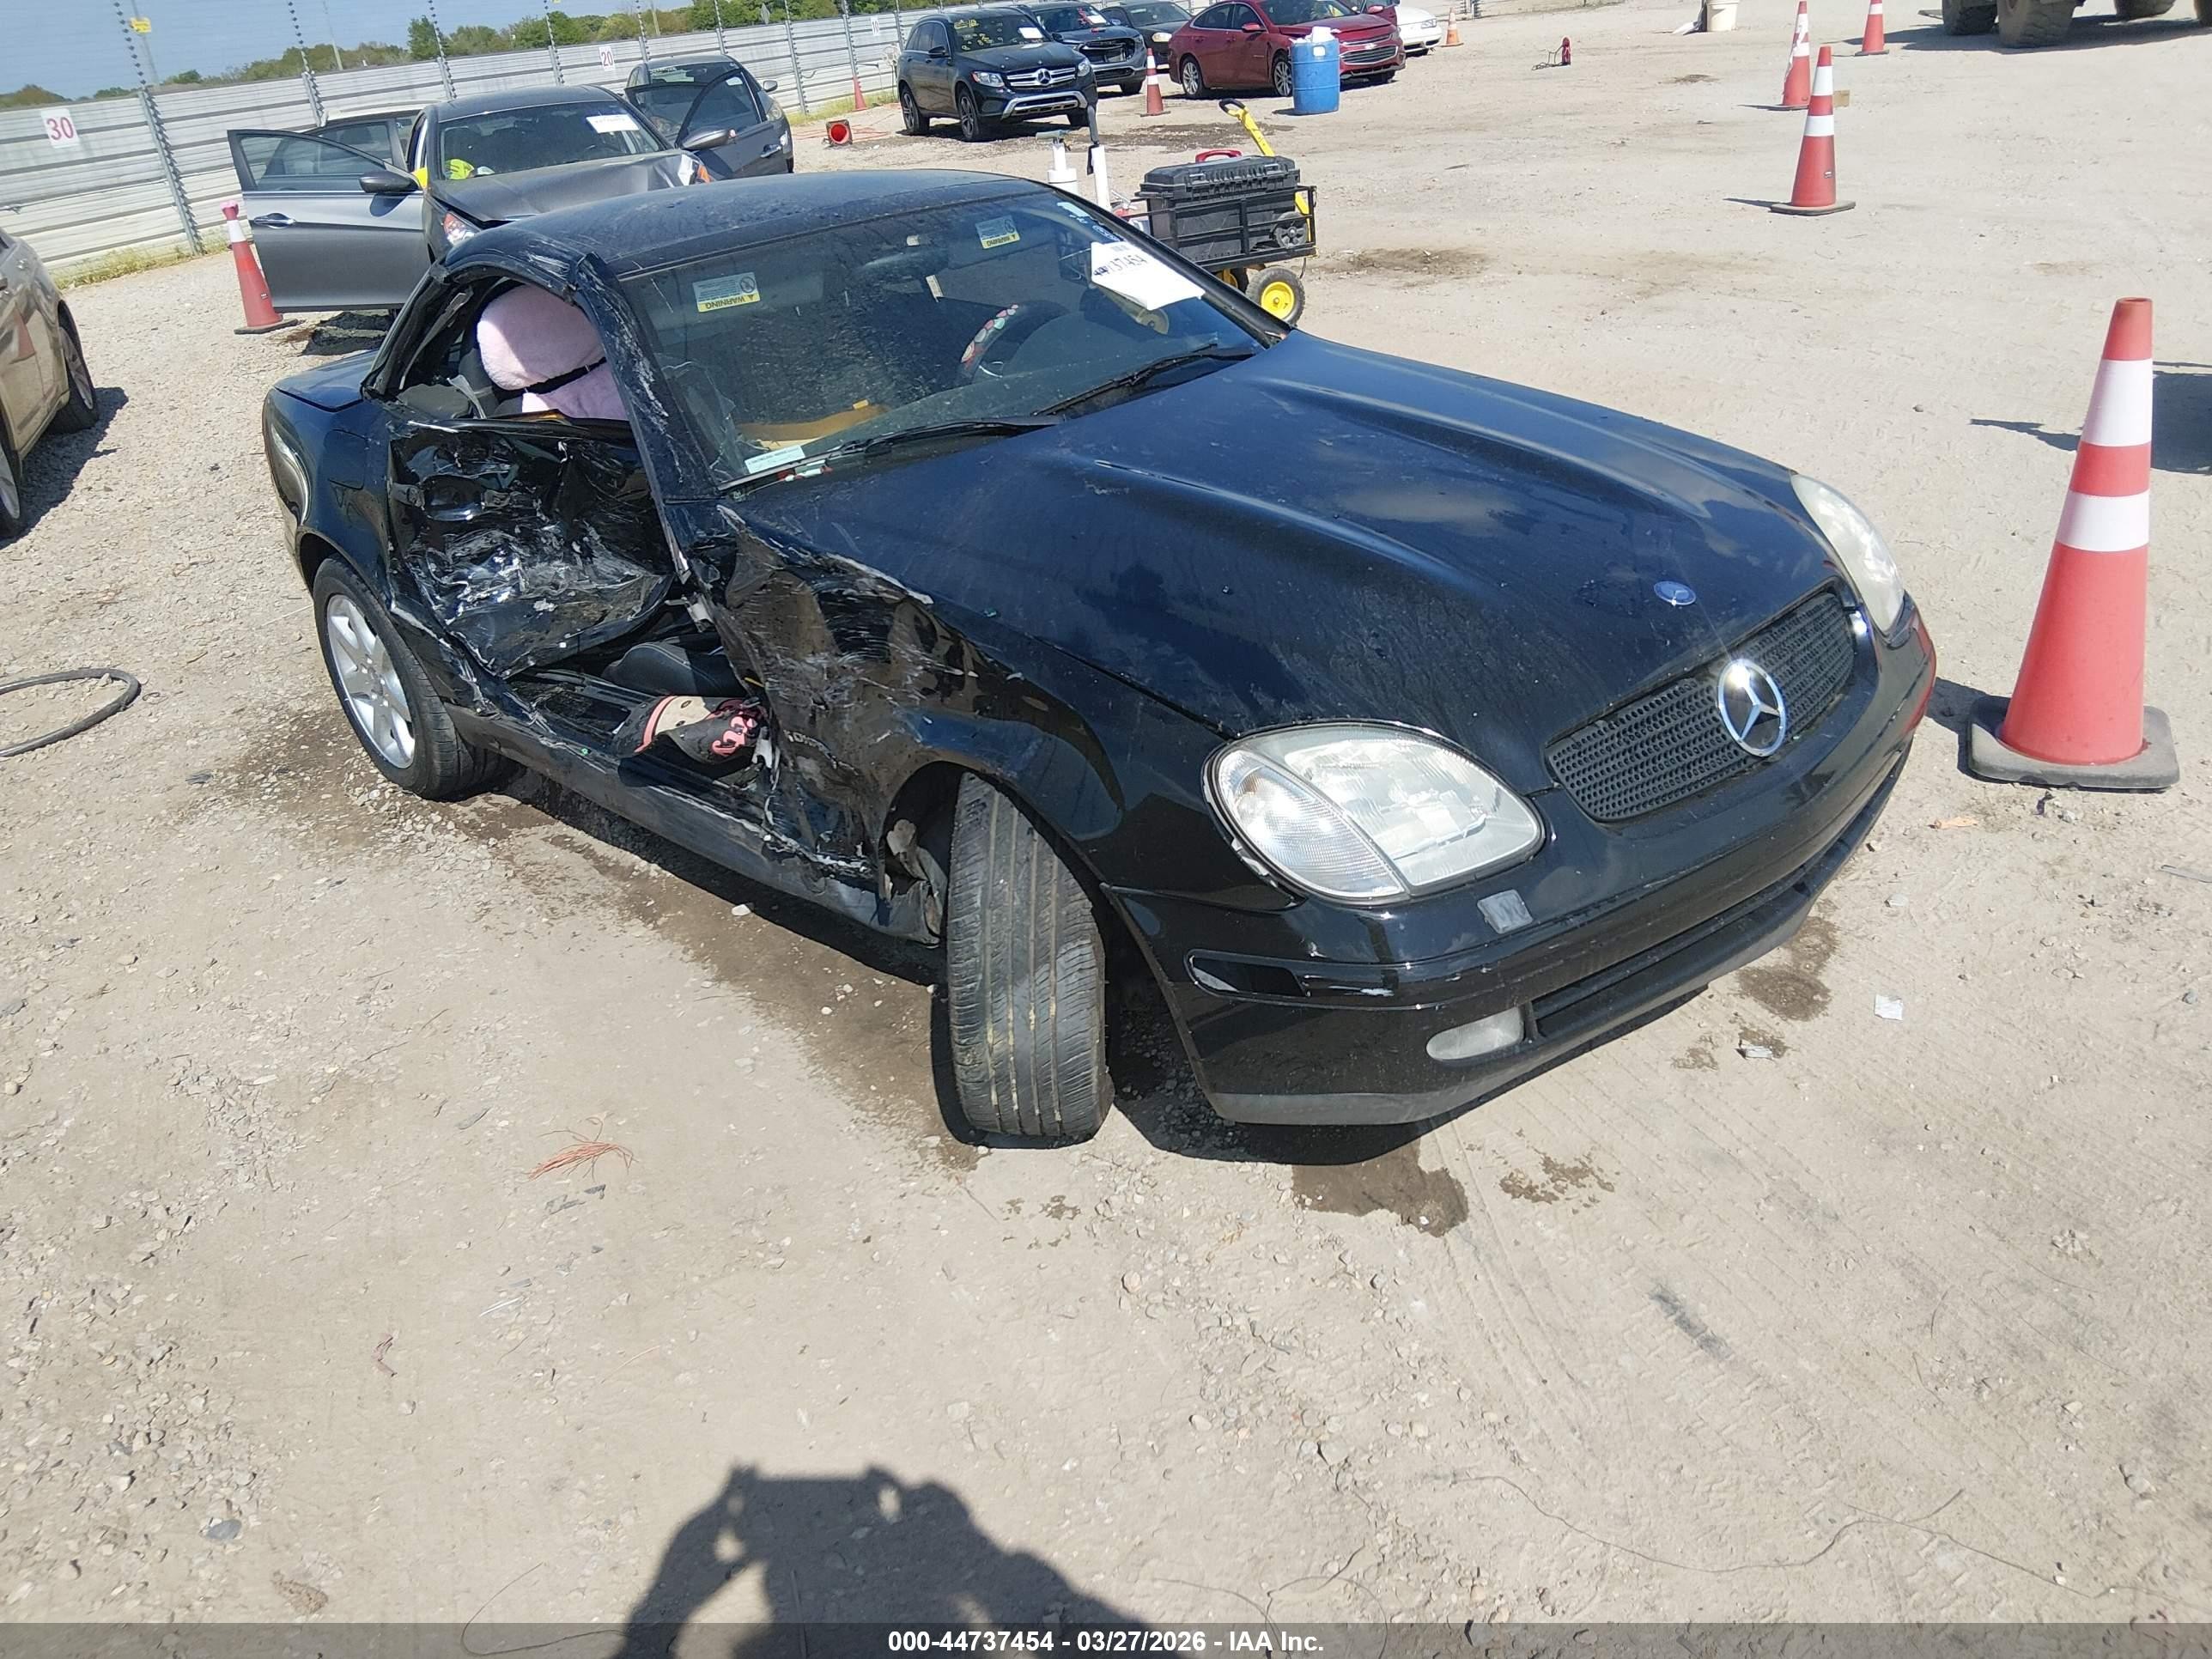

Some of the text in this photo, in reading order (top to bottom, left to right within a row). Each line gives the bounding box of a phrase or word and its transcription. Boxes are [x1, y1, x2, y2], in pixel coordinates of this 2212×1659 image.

[601, 52, 614, 66] 20
[46, 117, 74, 140] 30
[705, 295, 745, 309] WARNING
